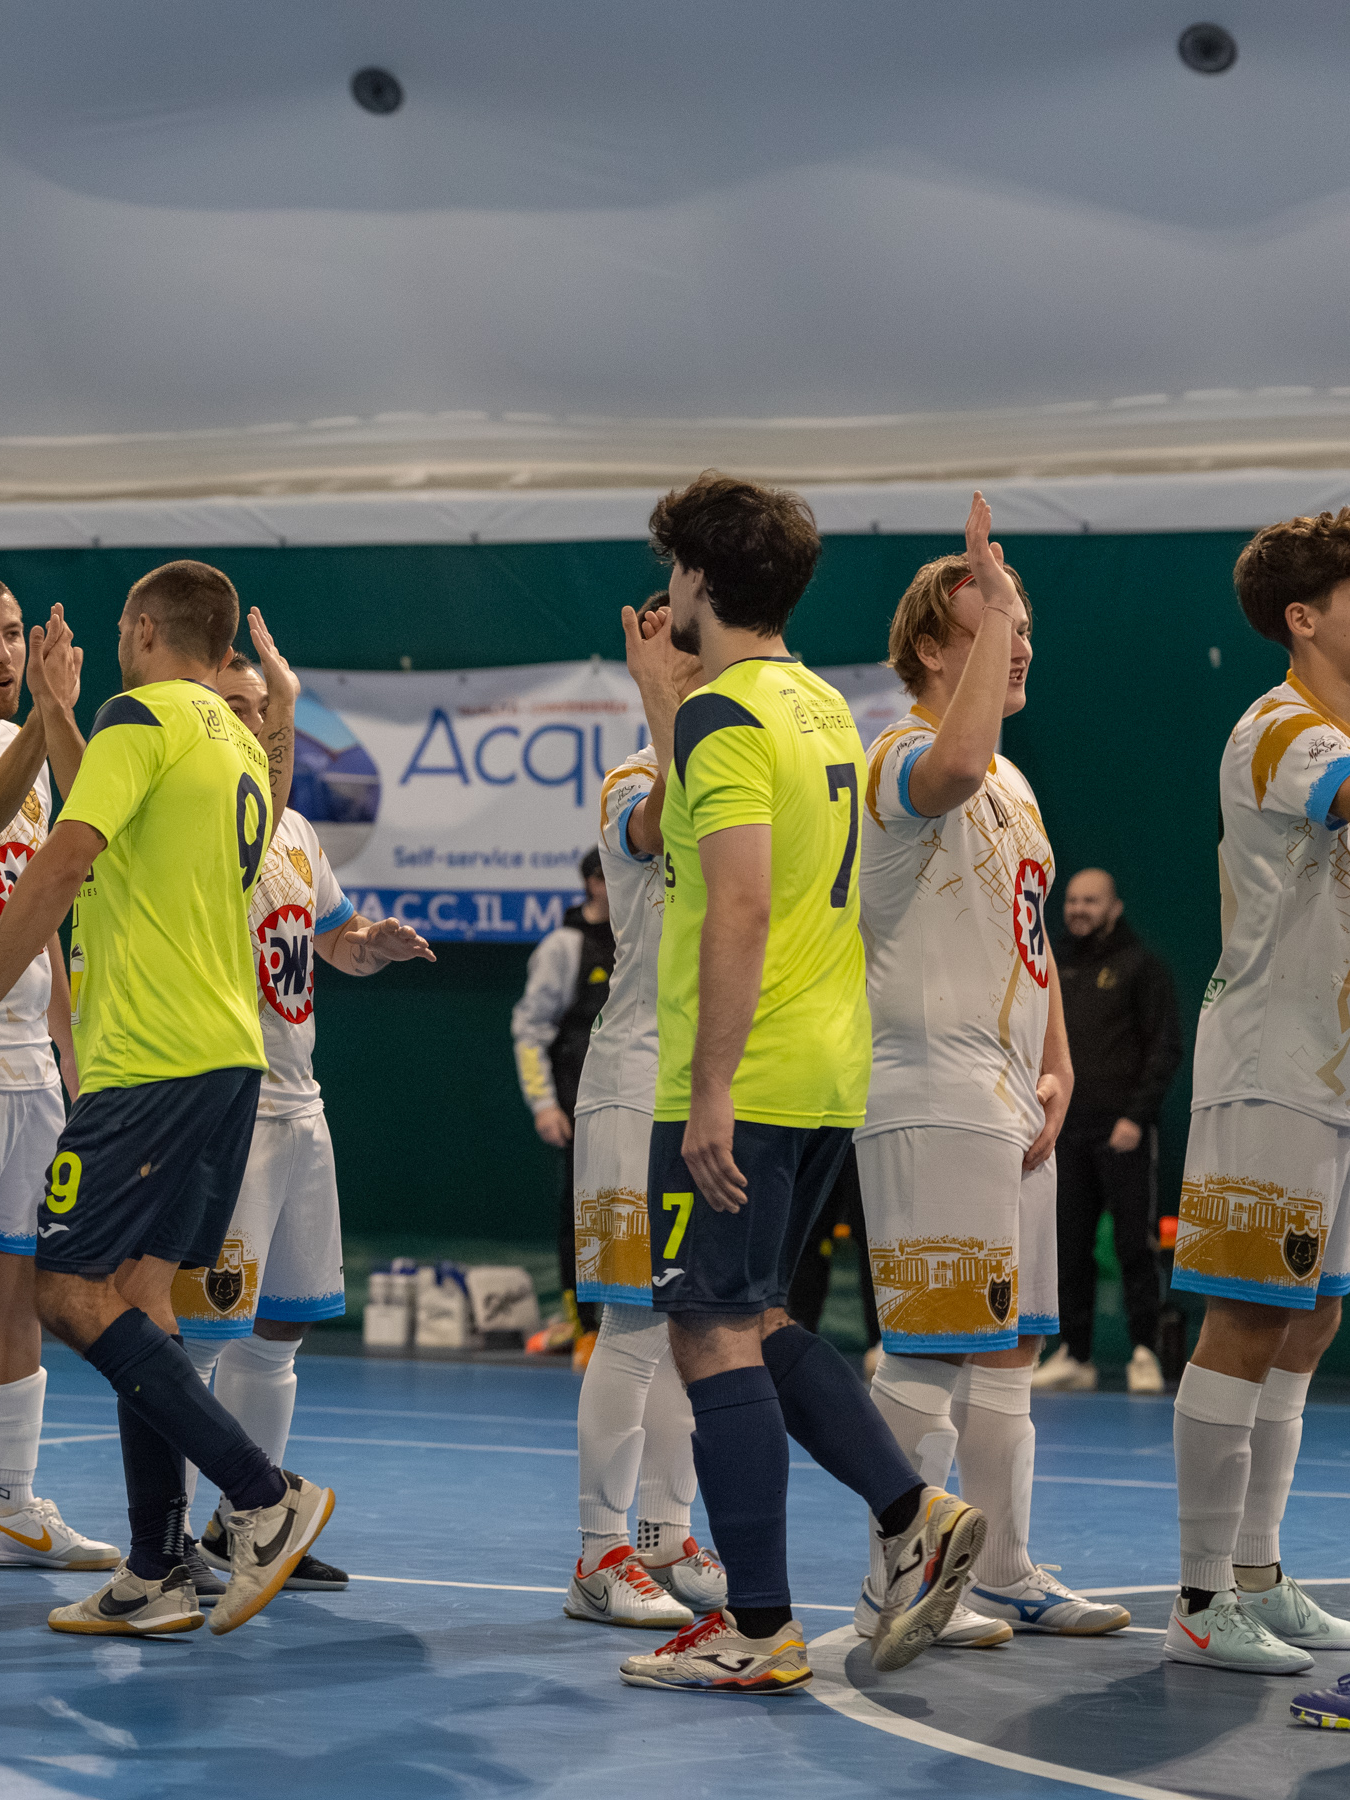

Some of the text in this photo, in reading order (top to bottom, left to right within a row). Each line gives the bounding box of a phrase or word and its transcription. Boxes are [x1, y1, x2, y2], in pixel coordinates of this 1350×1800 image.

[236, 771, 267, 893] 9
[825, 762, 859, 908] 7
[1023, 889, 1045, 956] P
[270, 934, 309, 996] PM
[46, 1151, 83, 1214] 9
[662, 1192, 694, 1259] 7
